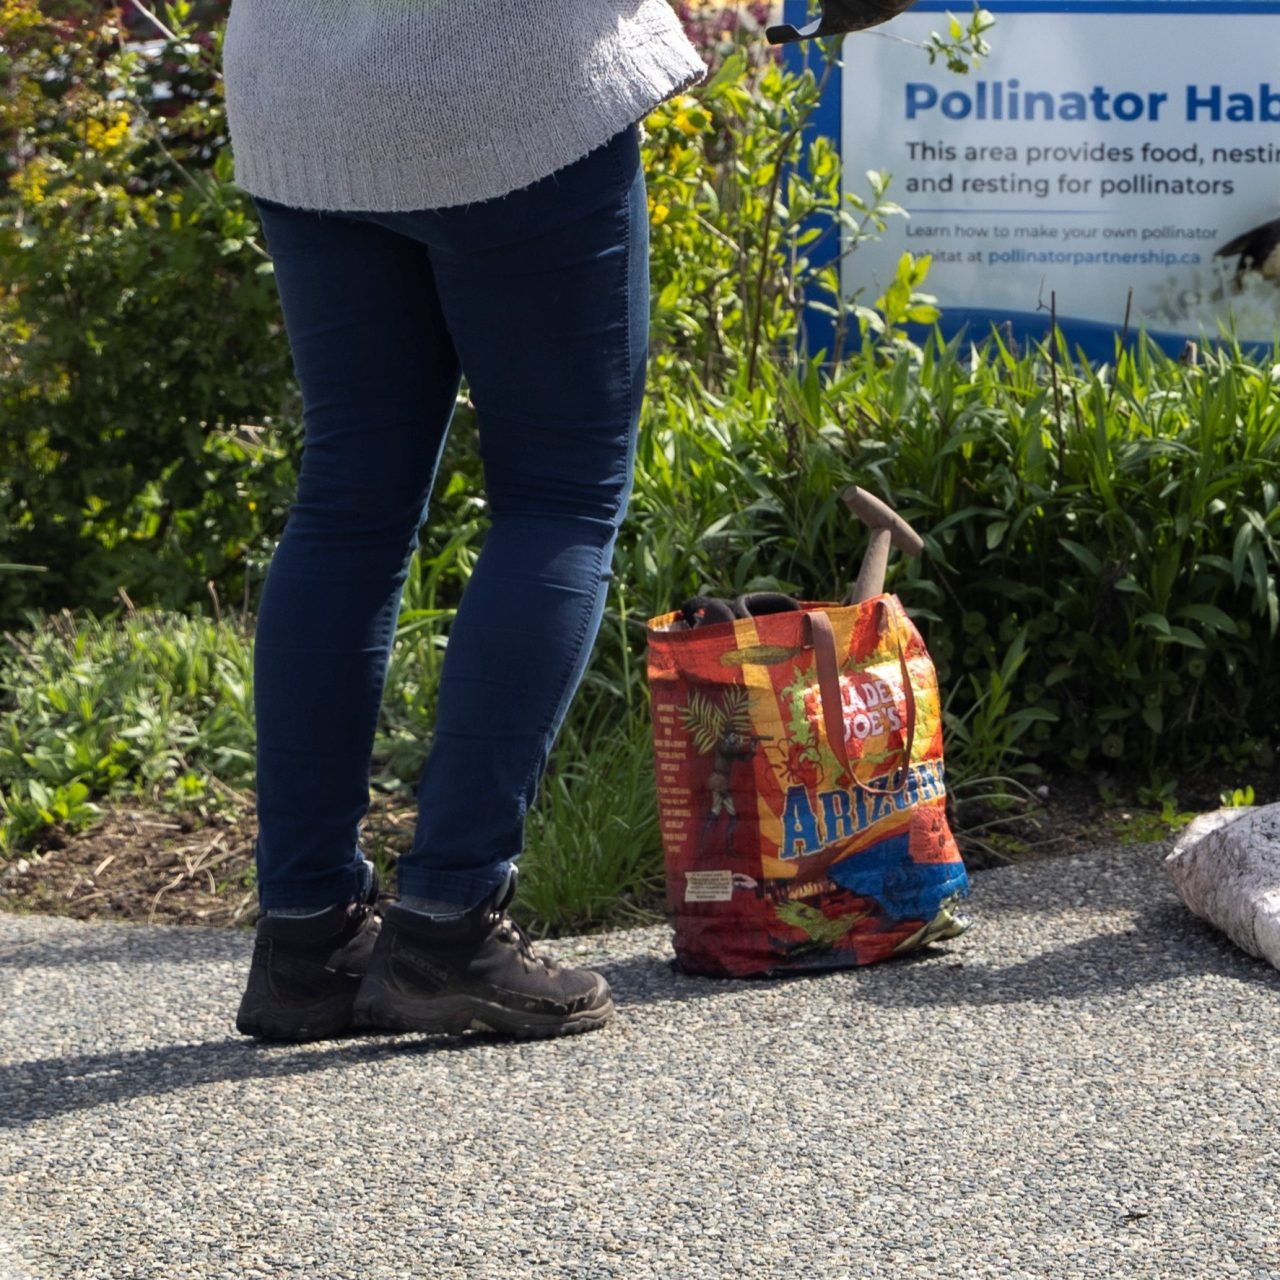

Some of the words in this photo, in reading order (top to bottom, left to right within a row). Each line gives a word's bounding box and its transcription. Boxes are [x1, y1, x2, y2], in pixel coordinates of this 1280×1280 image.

[905, 78, 1168, 122] Pollinator
[905, 140, 957, 161] This
[965, 145, 1018, 162] area
[1026, 142, 1135, 166] provides
[1142, 143, 1204, 166] food,
[906, 174, 953, 193] and
[962, 173, 1049, 198] resting
[1058, 174, 1092, 194] for
[1101, 174, 1235, 198] pollinators
[906, 225, 951, 238] Learn
[955, 225, 988, 238] how
[994, 225, 1011, 238] to
[1014, 225, 1059, 238] make
[1063, 227, 1098, 241] your
[1103, 228, 1137, 239] own
[1142, 226, 1218, 241] pollinator
[905, 249, 962, 263] abitat
[967, 251, 982, 263] at
[988, 249, 1201, 265] pollinatorpartnership.ca
